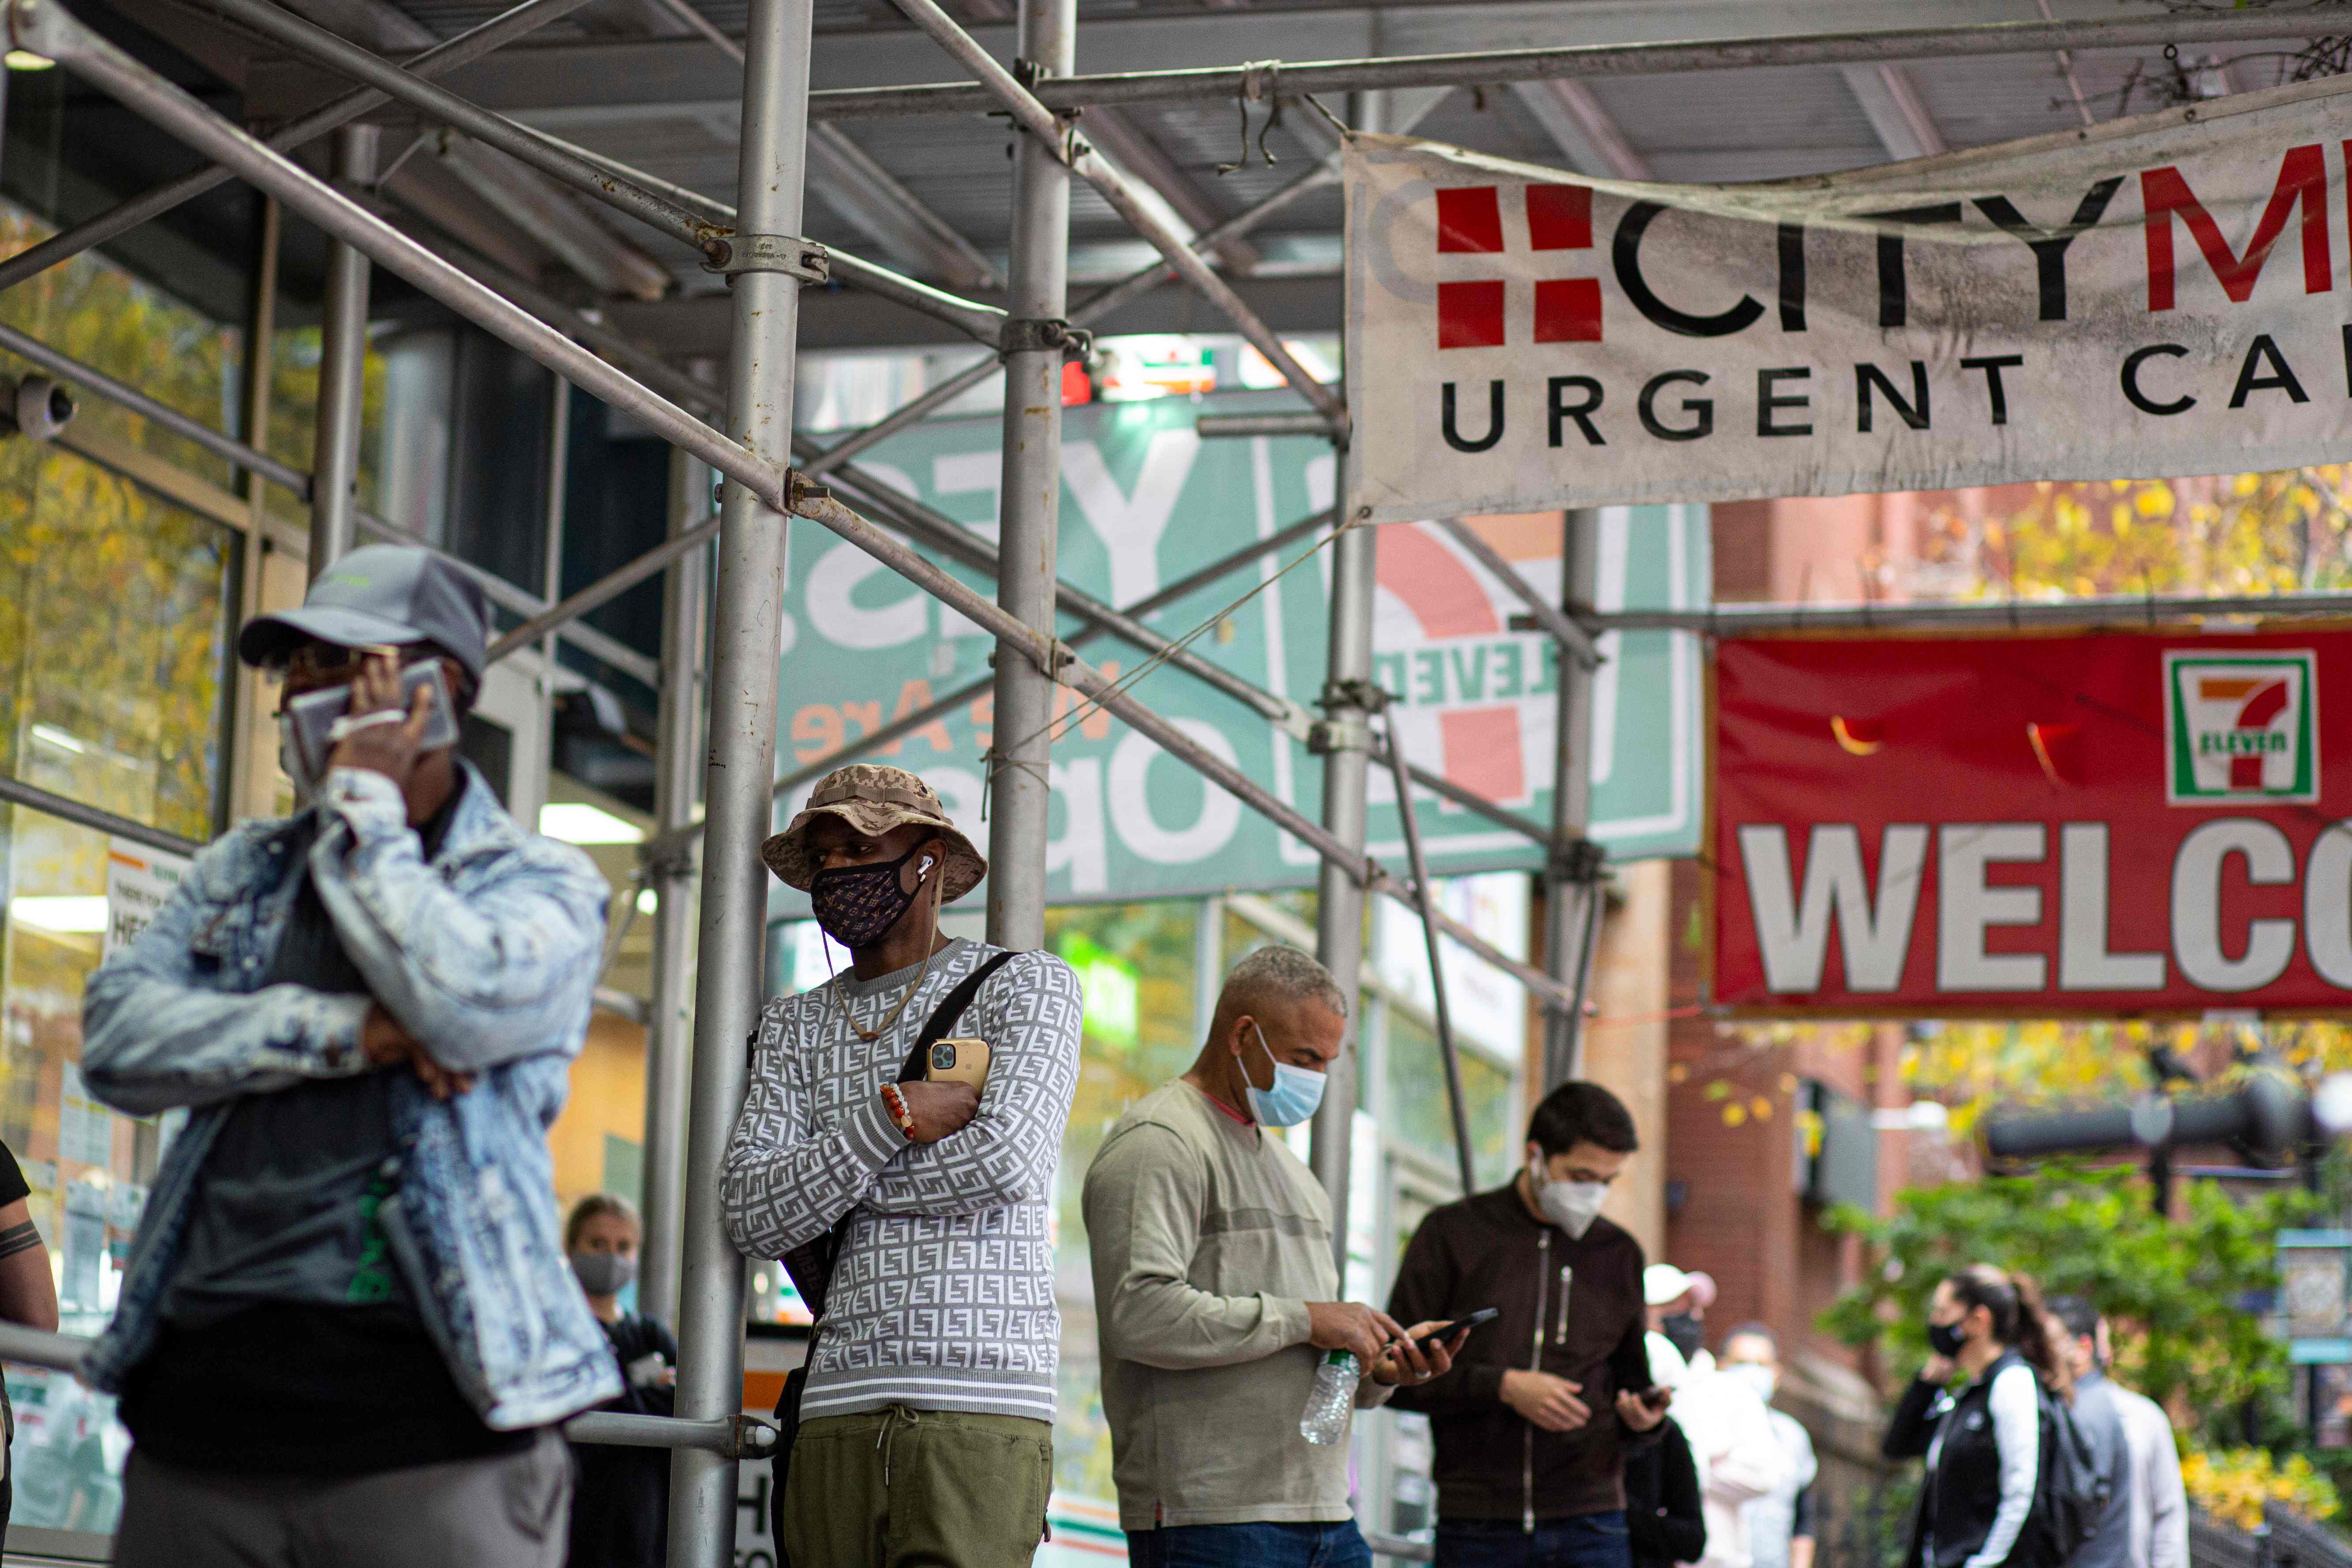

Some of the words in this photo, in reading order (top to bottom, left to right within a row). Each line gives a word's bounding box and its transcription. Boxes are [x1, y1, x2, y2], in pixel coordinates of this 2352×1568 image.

[1612, 139, 2352, 337] CITYM
[1442, 355, 2023, 453] URGENT
[2120, 324, 2352, 416] CA
